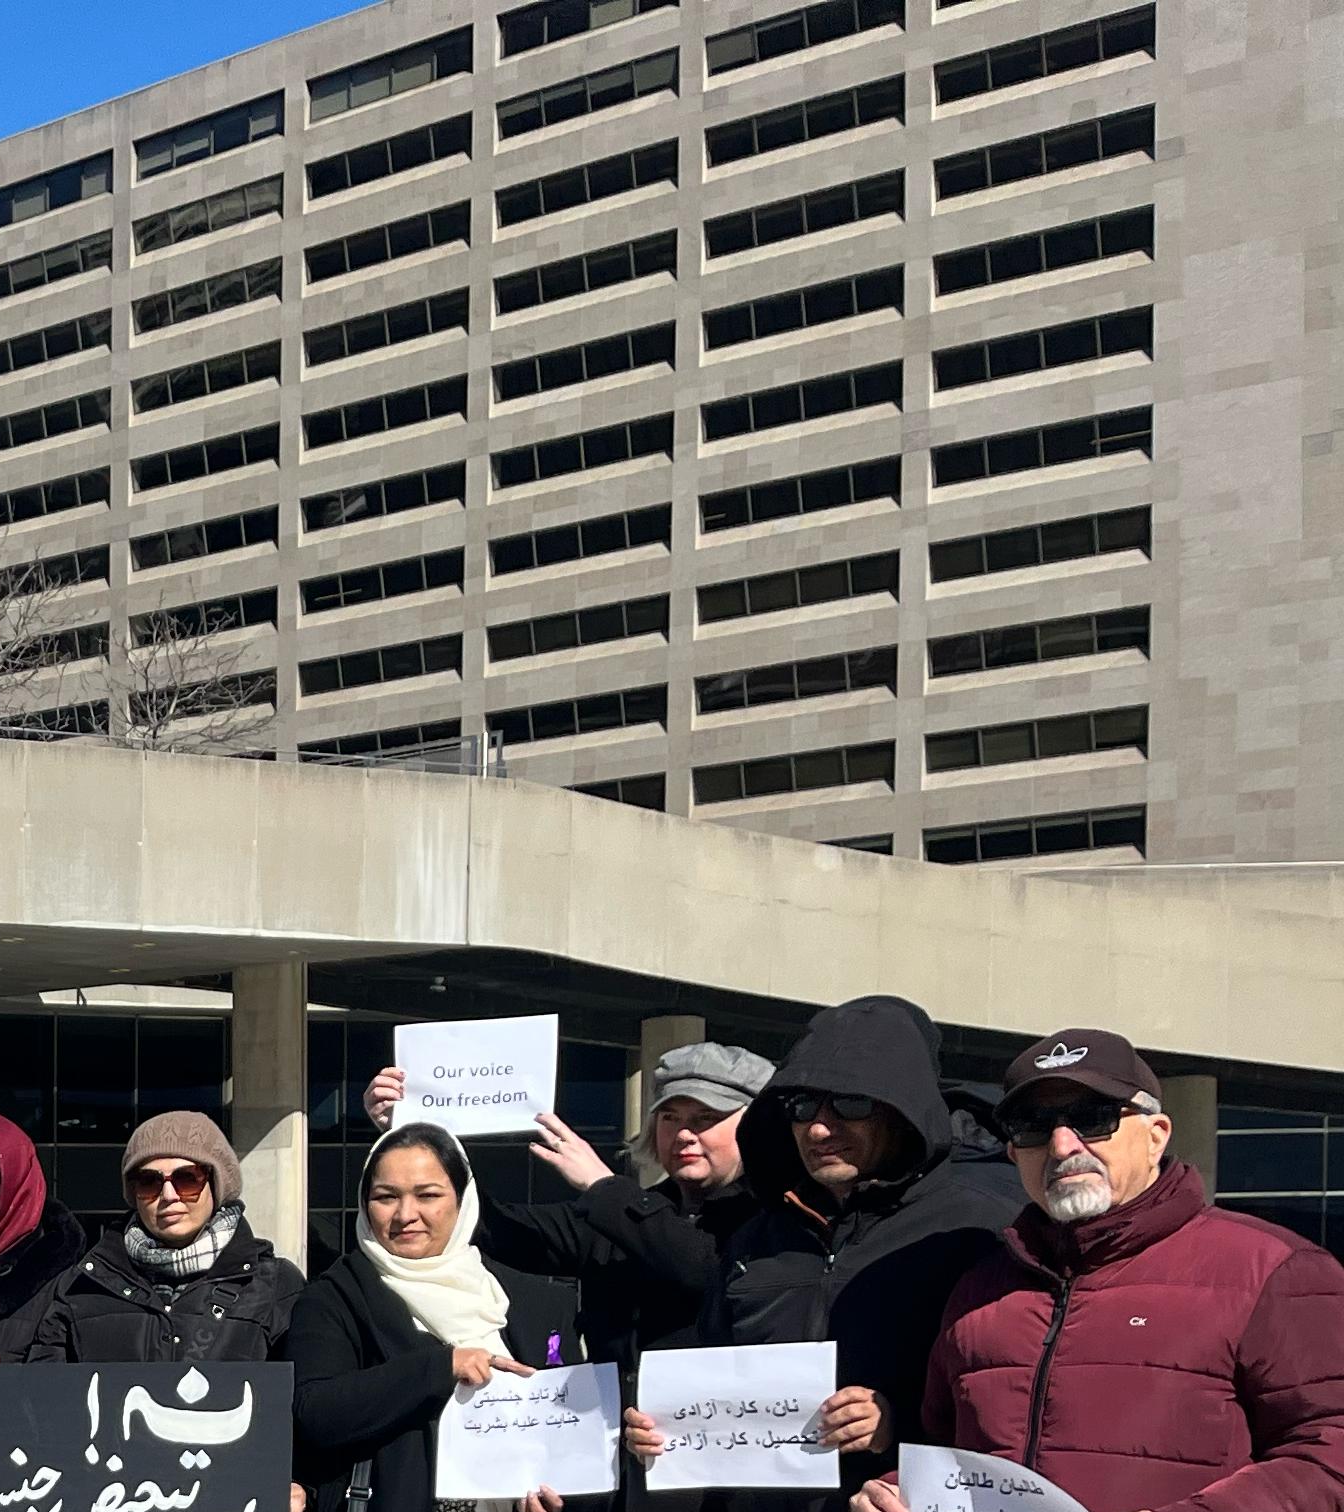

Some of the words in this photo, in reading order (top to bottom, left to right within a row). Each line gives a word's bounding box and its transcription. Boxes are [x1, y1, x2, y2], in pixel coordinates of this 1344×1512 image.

[433, 1065, 464, 1079] Our
[469, 1062, 514, 1077] voice
[422, 1094, 453, 1107] Our
[458, 1090, 528, 1107] freedom
[1129, 1316, 1148, 1326] CK
